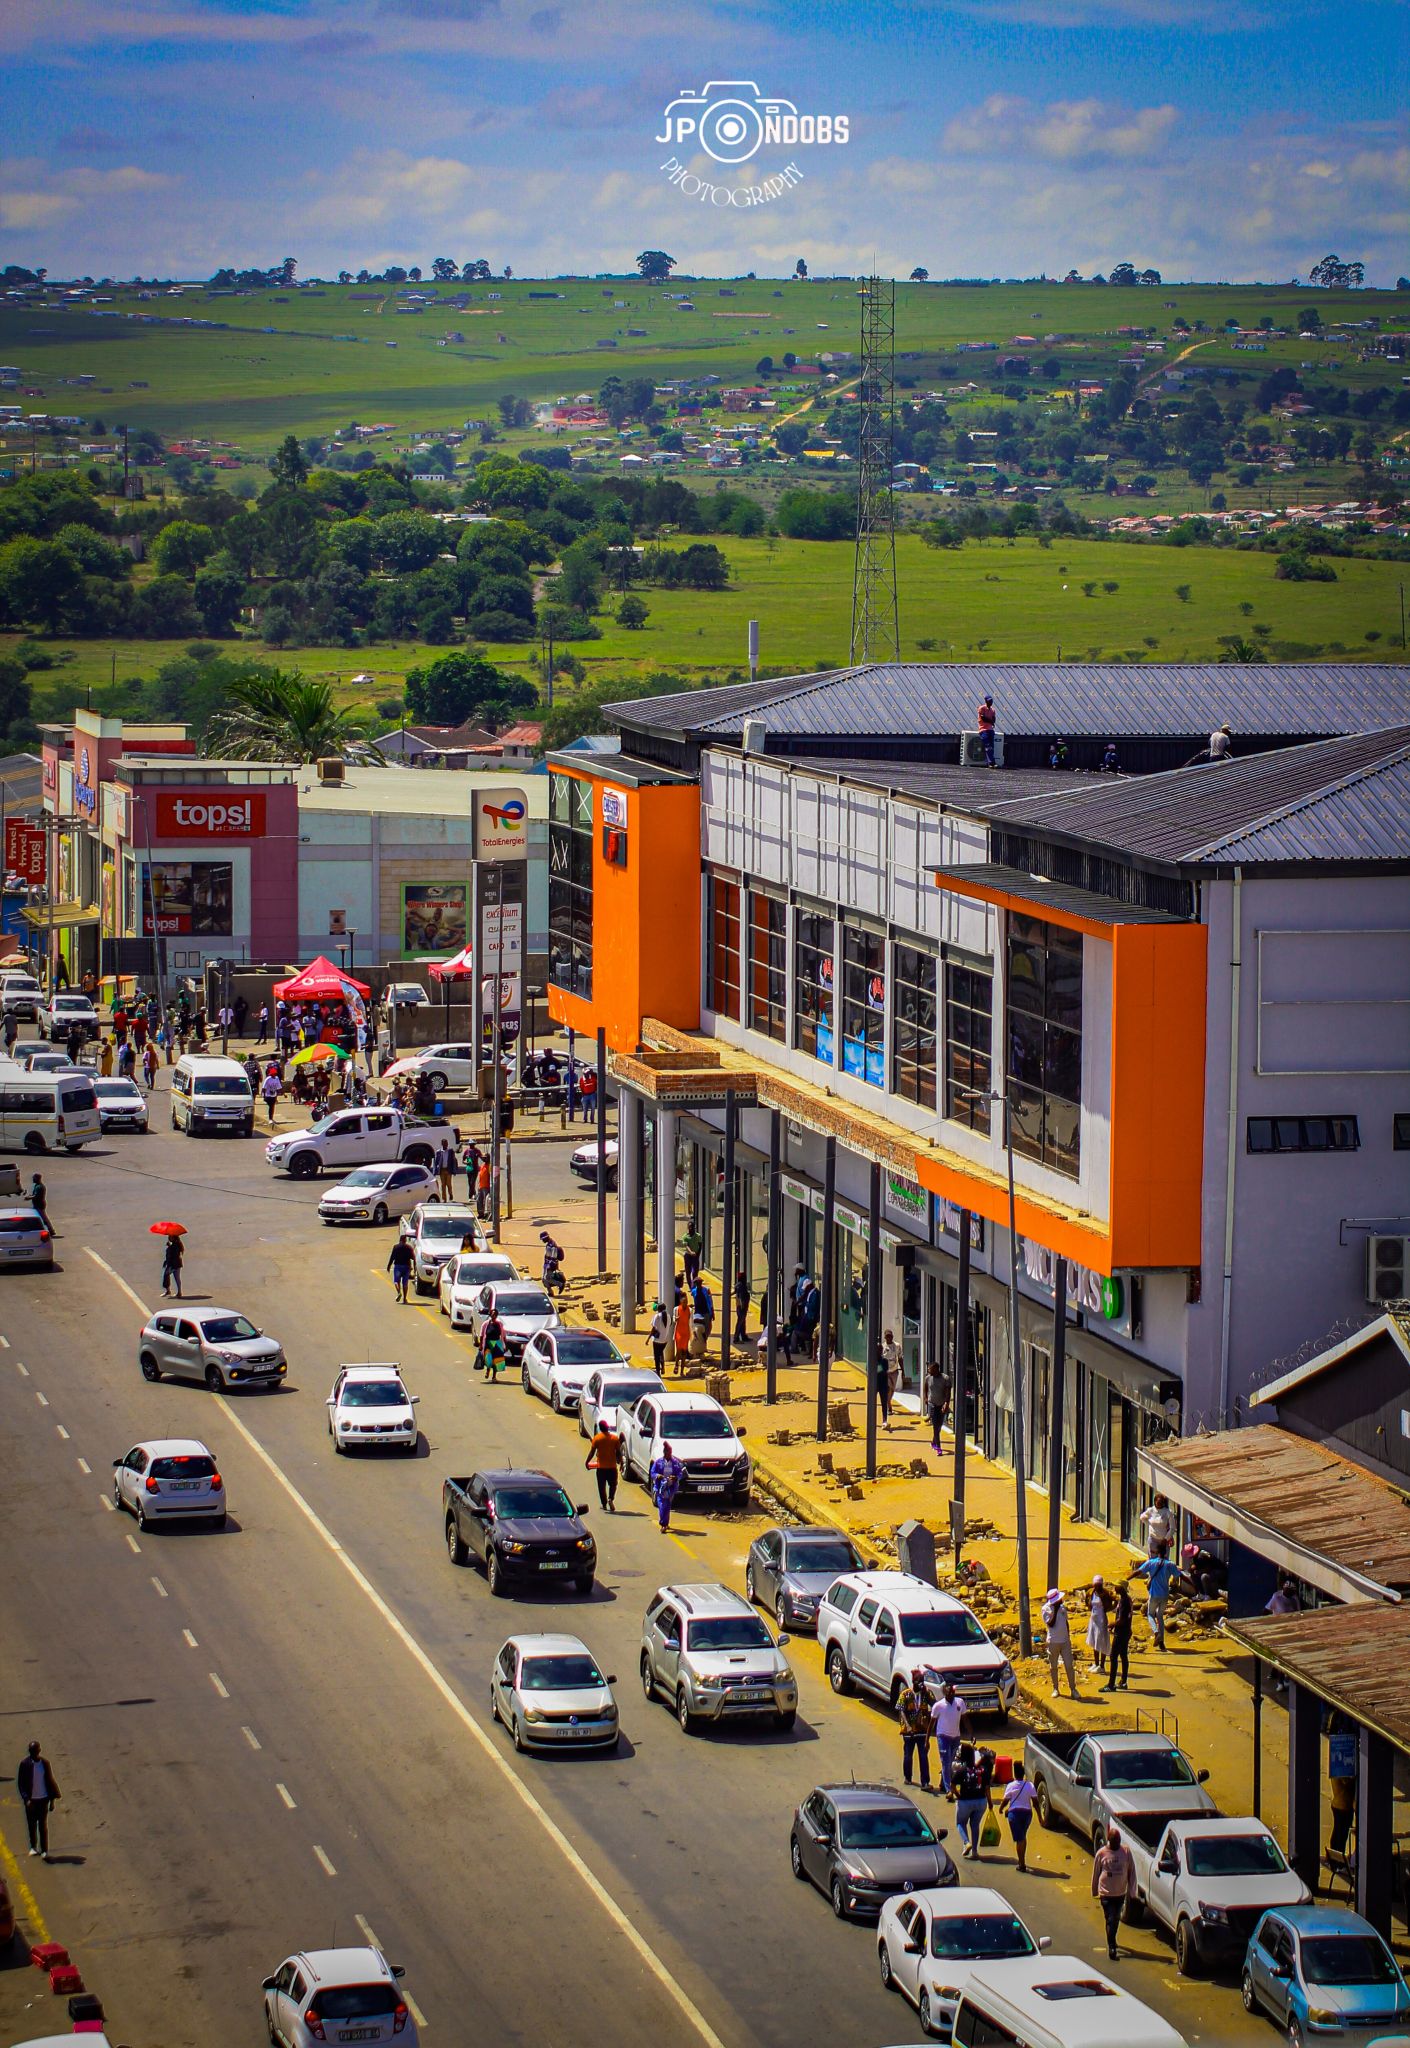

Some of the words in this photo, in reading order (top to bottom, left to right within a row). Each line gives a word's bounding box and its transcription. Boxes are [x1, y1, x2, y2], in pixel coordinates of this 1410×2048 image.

[172, 799, 251, 831] tops!
[28, 840, 44, 875] tops!
[482, 837, 526, 847] TotalEnergies
[488, 924, 517, 933] QURTZ
[1039, 1244, 1102, 1313] CLCKS
